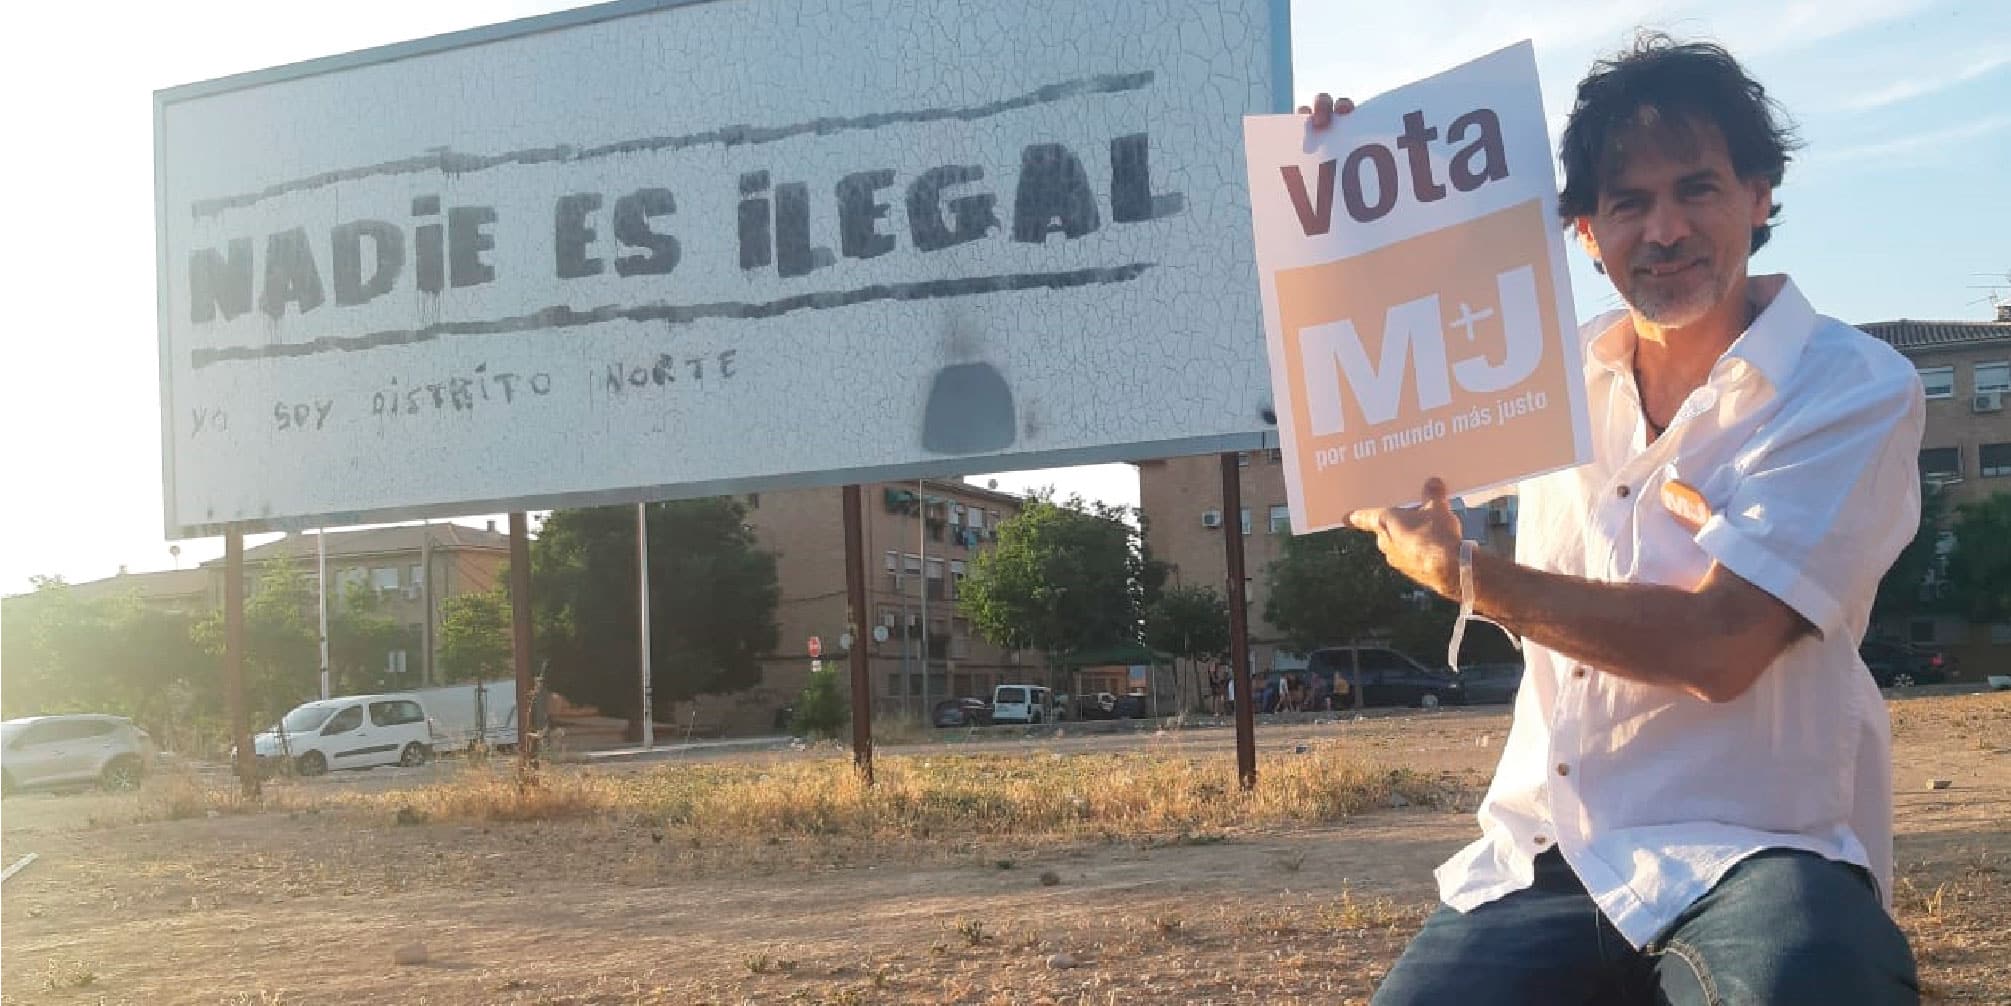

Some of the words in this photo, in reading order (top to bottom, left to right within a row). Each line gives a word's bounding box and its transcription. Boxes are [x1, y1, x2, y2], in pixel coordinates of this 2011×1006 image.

[1280, 108, 1509, 236] vota
[554, 187, 682, 280] ES
[274, 400, 334, 431] SOY
[606, 350, 737, 395] NORTE
[1315, 445, 1346, 471] por
[1353, 439, 1377, 460] un
[1383, 418, 1446, 453] mundo
[1452, 405, 1493, 433] más
[1496, 391, 1547, 425] justo
